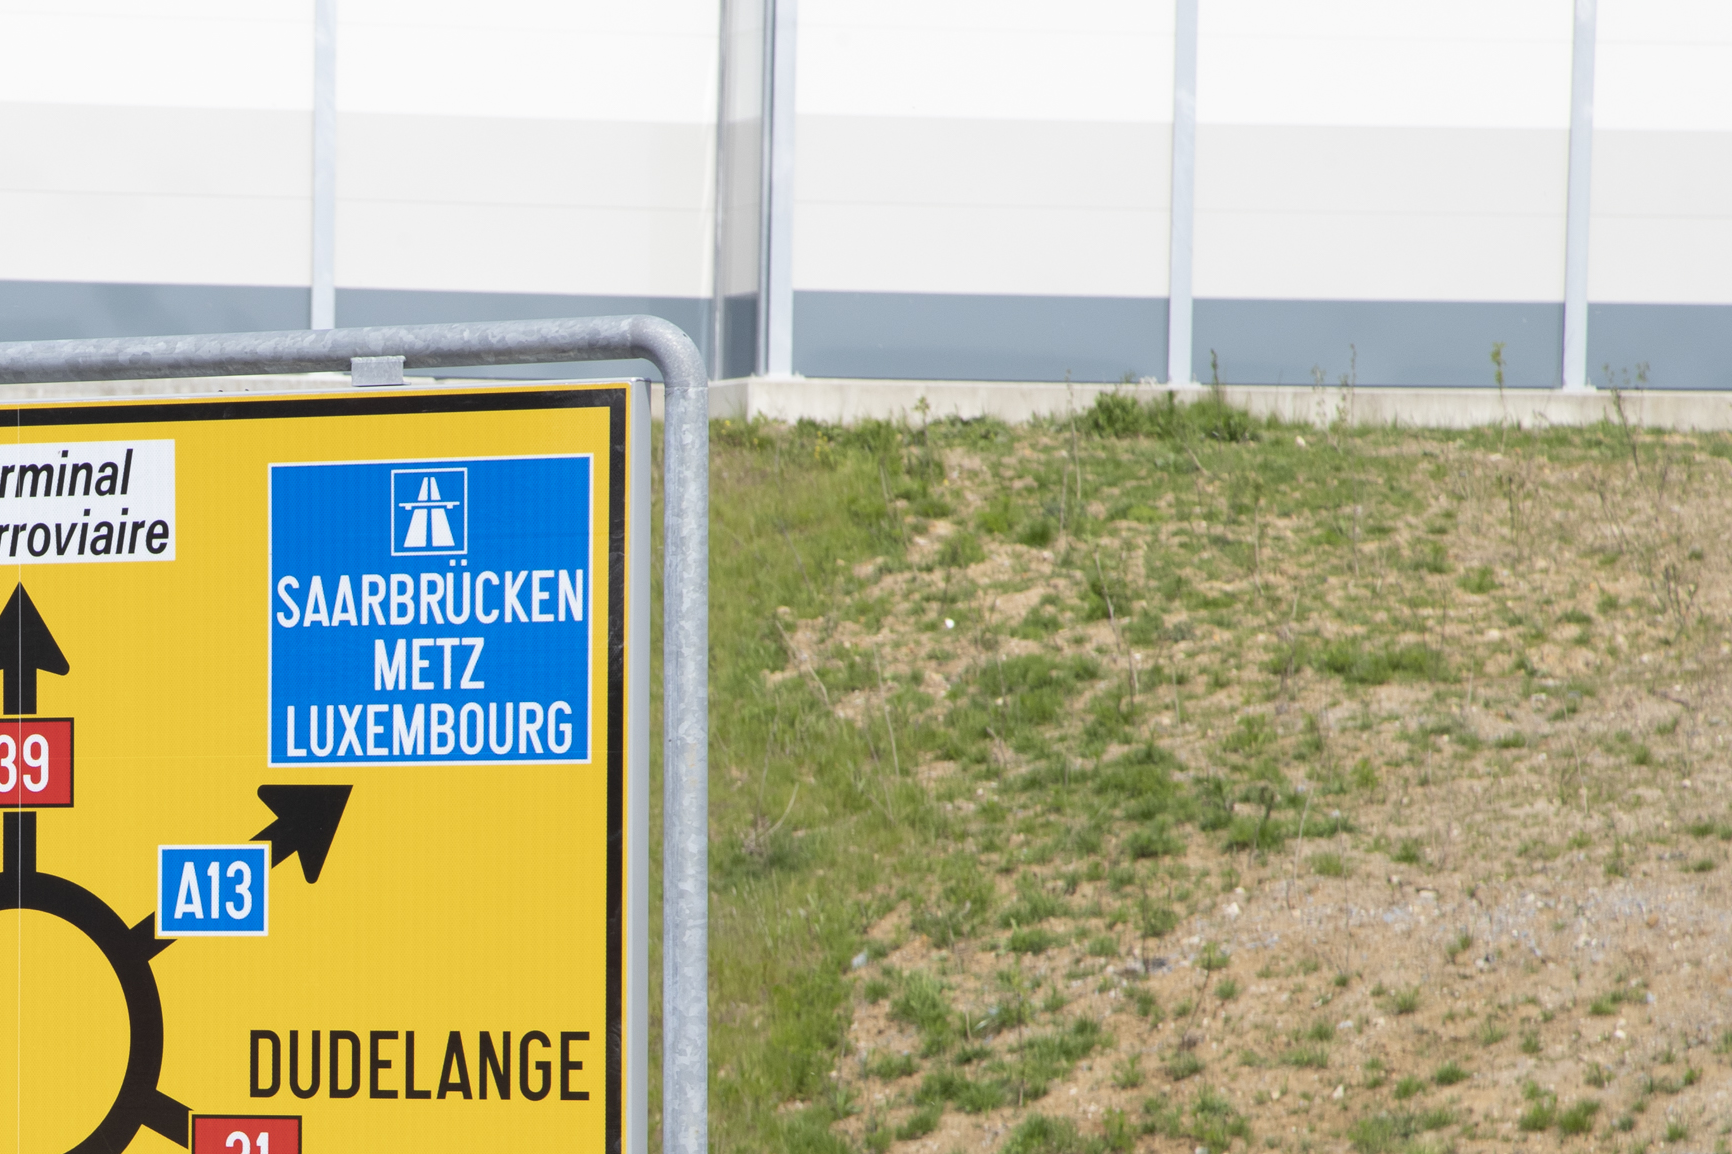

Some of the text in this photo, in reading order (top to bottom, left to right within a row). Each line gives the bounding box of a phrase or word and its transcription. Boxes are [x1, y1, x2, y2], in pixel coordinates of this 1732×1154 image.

[276, 559, 584, 628] SAARBRÜCKEN
[373, 637, 485, 691] METZ
[286, 700, 573, 758] LUXEMBOURG
[174, 861, 253, 921] A13
[249, 1030, 591, 1102] DUDELANGE
